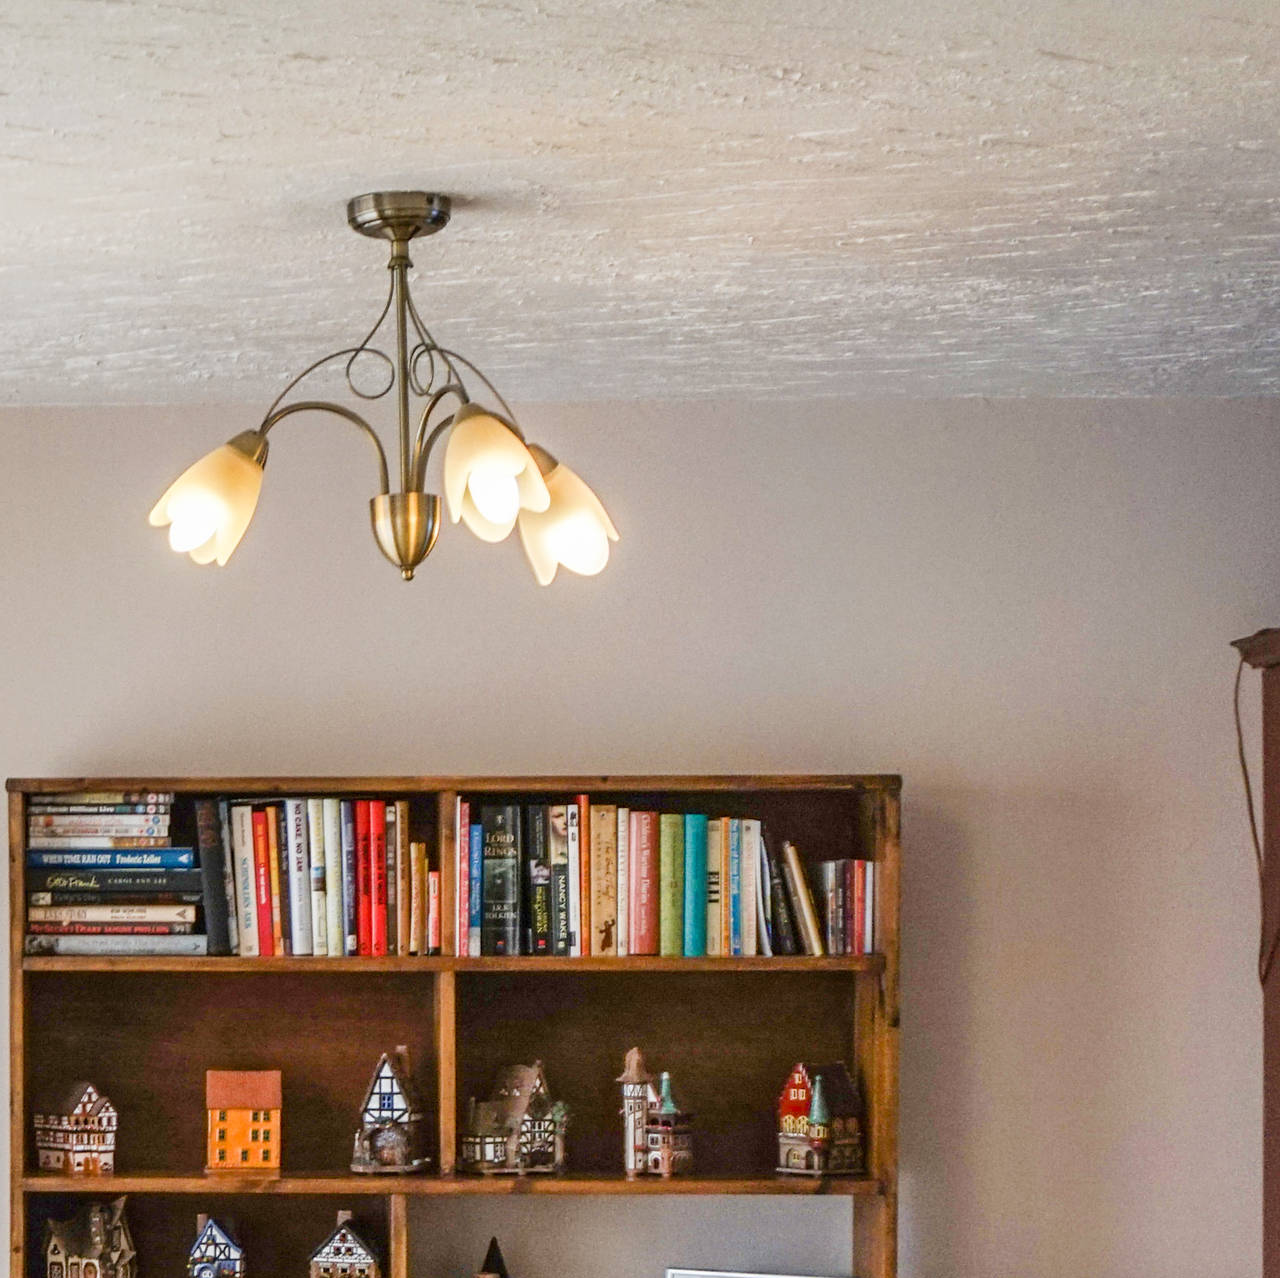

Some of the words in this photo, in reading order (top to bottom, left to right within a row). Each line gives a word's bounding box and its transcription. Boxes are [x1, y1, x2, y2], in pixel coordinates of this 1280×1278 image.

[294, 803, 302, 815] NO
[486, 832, 515, 843] LORD
[295, 843, 303, 854] NO
[42, 854, 63, 865] WHEN
[63, 854, 81, 865] TIME
[81, 854, 97, 865] RAN
[97, 854, 112, 865] OUT
[295, 856, 303, 872] JAM
[557, 874, 567, 909] NANCY
[559, 911, 568, 939] WAKE
